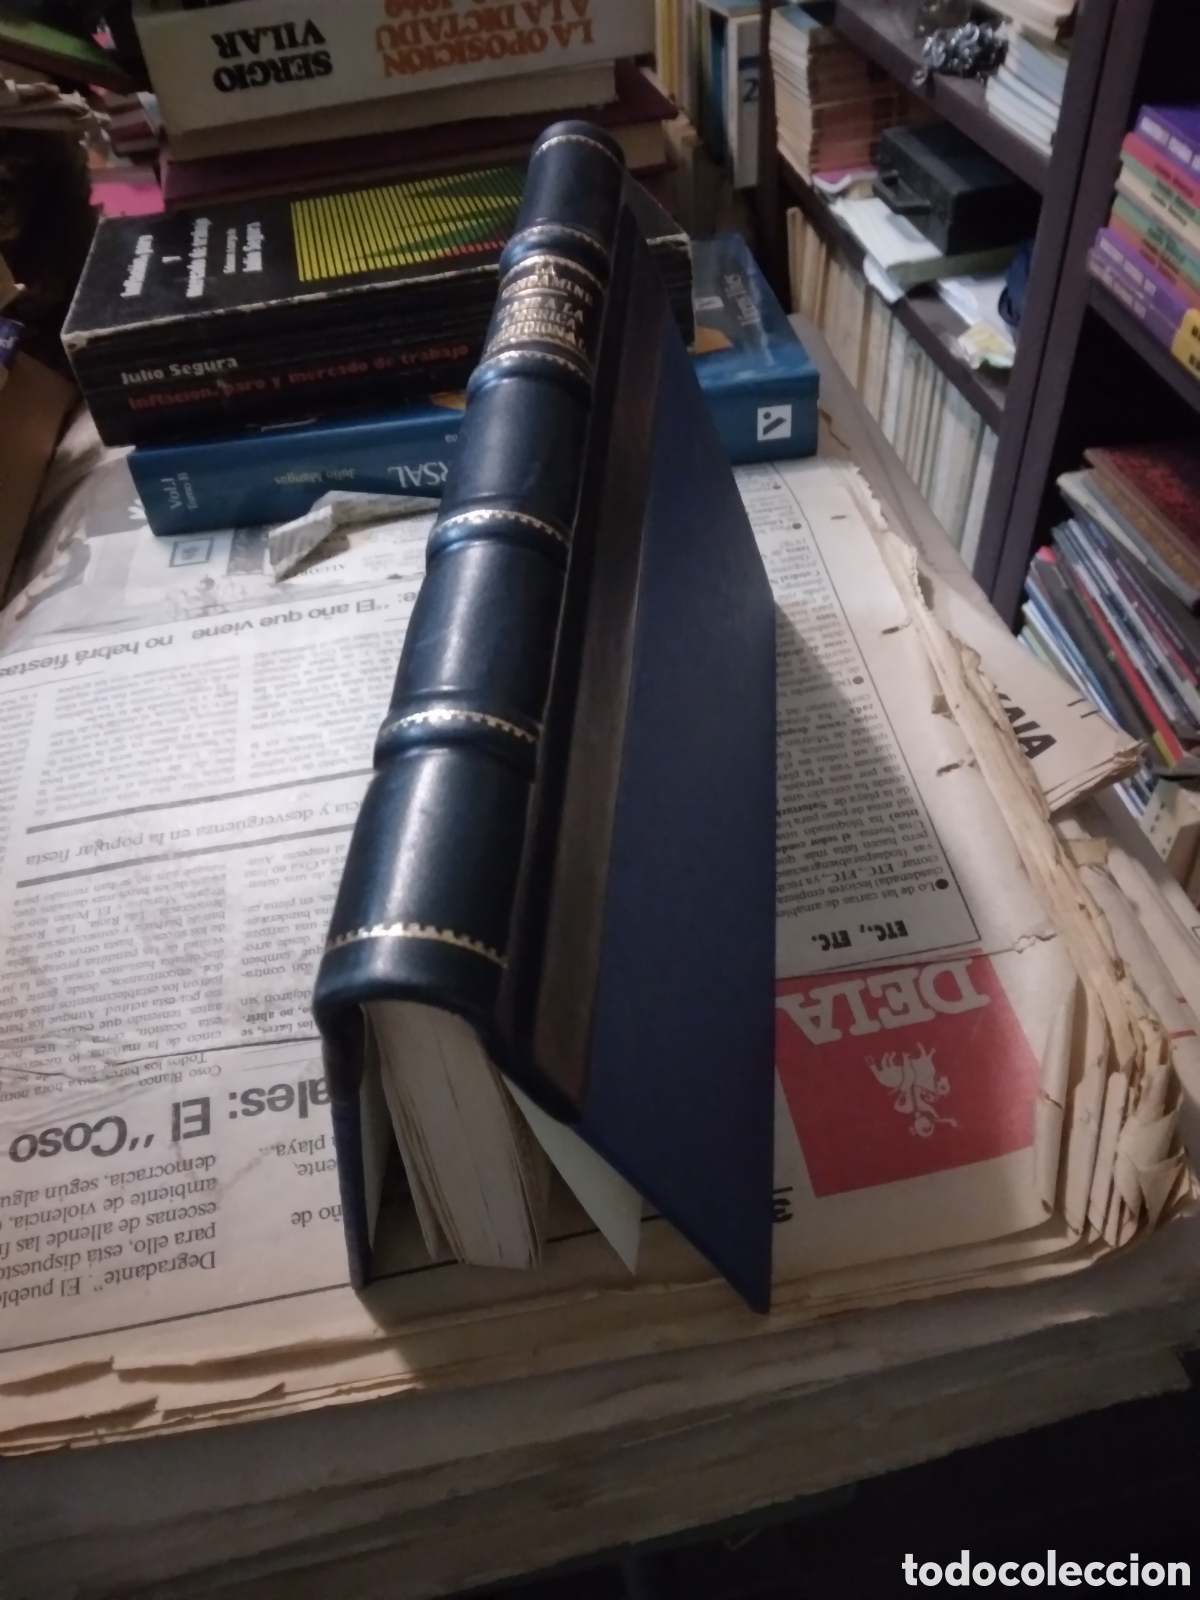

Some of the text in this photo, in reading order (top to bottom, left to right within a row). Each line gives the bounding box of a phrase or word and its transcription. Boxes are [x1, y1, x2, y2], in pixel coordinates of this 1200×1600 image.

[376, 4, 516, 50] DICTADU
[551, 19, 595, 47] LA
[211, 19, 326, 58] VILAR
[212, 51, 332, 93] SERGIO
[121, 354, 238, 385] Julio Segura
[222, 377, 266, 398] paro
[271, 374, 282, 390] y
[288, 359, 369, 383] mercado
[373, 354, 396, 370] de
[402, 343, 470, 366] trabajo
[259, 609, 304, 629] que
[307, 603, 350, 621] año
[191, 619, 255, 641] viene
[144, 633, 174, 649] no
[74, 637, 140, 666] habrá
[853, 781, 869, 792] ha
[871, 773, 906, 787] conde
[833, 797, 847, 808] de
[850, 789, 880, 804] playa
[882, 788, 893, 799] la
[319, 802, 330, 818] y
[851, 805, 865, 817] de
[866, 800, 893, 812] zona
[793, 811, 819, 825] para
[803, 816, 863, 837] bloqueado
[868, 814, 884, 826] ha
[75, 829, 144, 858] popular
[168, 829, 192, 842] en
[809, 834, 838, 848] señor
[841, 831, 851, 842] el
[862, 835, 897, 851] hacen
[901, 829, 929, 843] pero
[803, 847, 828, 862] más
[832, 842, 858, 856] falta
[912, 842, 934, 853] vas
[25, 848, 70, 866] fiesta
[805, 873, 820, 888] ya
[827, 879, 872, 895] lectores
[824, 881, 935, 910] Lo de las cartas de
[811, 919, 908, 952] ETC., ETC.
[292, 961, 314, 972] son
[162, 982, 179, 994] los
[58, 985, 159, 1011] establecimientos
[775, 960, 990, 1045] DEIA
[48, 1008, 97, 1027] Aunque
[99, 1009, 182, 1030] teniendo que
[147, 1029, 222, 1050] cinco de la
[240, 1028, 254, 1037] se
[143, 1059, 163, 1074] los
[166, 1051, 208, 1067] Todos
[138, 1064, 222, 1088] Coso Blanco
[171, 1096, 212, 1143] El
[104, 1154, 217, 1189] democracia,
[44, 1178, 99, 1201] según
[130, 1177, 217, 1207] ambiente
[103, 1196, 125, 1214] de
[146, 1201, 217, 1227] escenas
[9, 1201, 96, 1231] violencia,
[118, 1216, 141, 1234] de
[290, 1209, 313, 1227] de
[46, 1221, 114, 1249] allende
[174, 1221, 217, 1246] para
[16, 1235, 41, 1255] las
[128, 1235, 169, 1255] ello,
[86, 1243, 123, 1268] está
[60, 1276, 82, 1298] El
